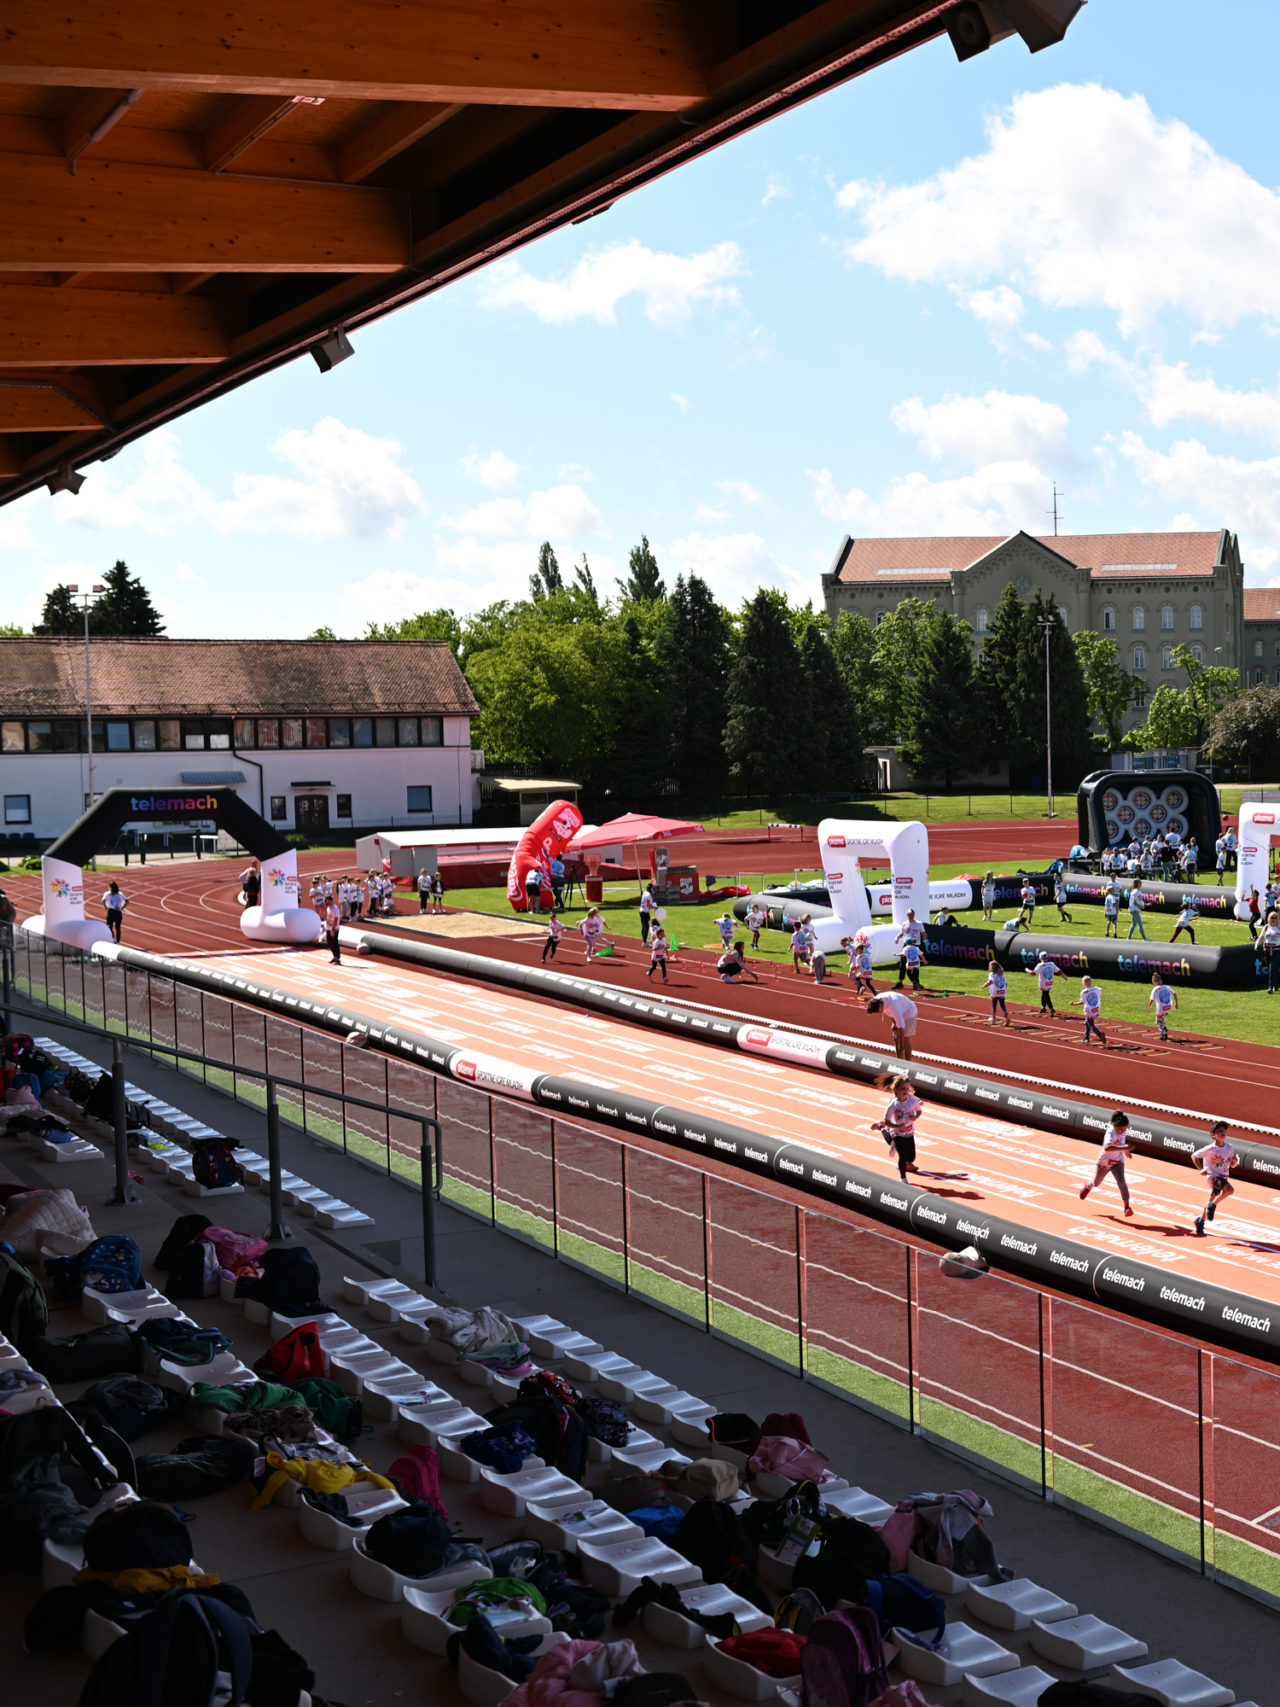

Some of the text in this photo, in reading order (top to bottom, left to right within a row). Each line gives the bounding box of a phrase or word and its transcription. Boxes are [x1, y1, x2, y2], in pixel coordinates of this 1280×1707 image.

[131, 795, 218, 812] telemach
[1182, 894, 1227, 909] telemach
[924, 939, 995, 961] telemach
[1021, 948, 1089, 969] telmach
[1117, 955, 1191, 977] telemach
[1041, 1104, 1069, 1120] telemach
[1163, 1136, 1195, 1153] telemach
[812, 1168, 837, 1187] telemach
[845, 1179, 872, 1198] telemach
[879, 1191, 907, 1211] telemach
[916, 1205, 947, 1225] telemach
[956, 1218, 989, 1240] telemach
[1000, 1234, 1037, 1256] telemach
[1066, 1225, 1187, 1263] telemach
[1049, 1249, 1089, 1273] telemach
[1102, 1266, 1145, 1292] telemach
[1159, 1285, 1205, 1311] telemach
[1221, 1305, 1271, 1333] telemach
